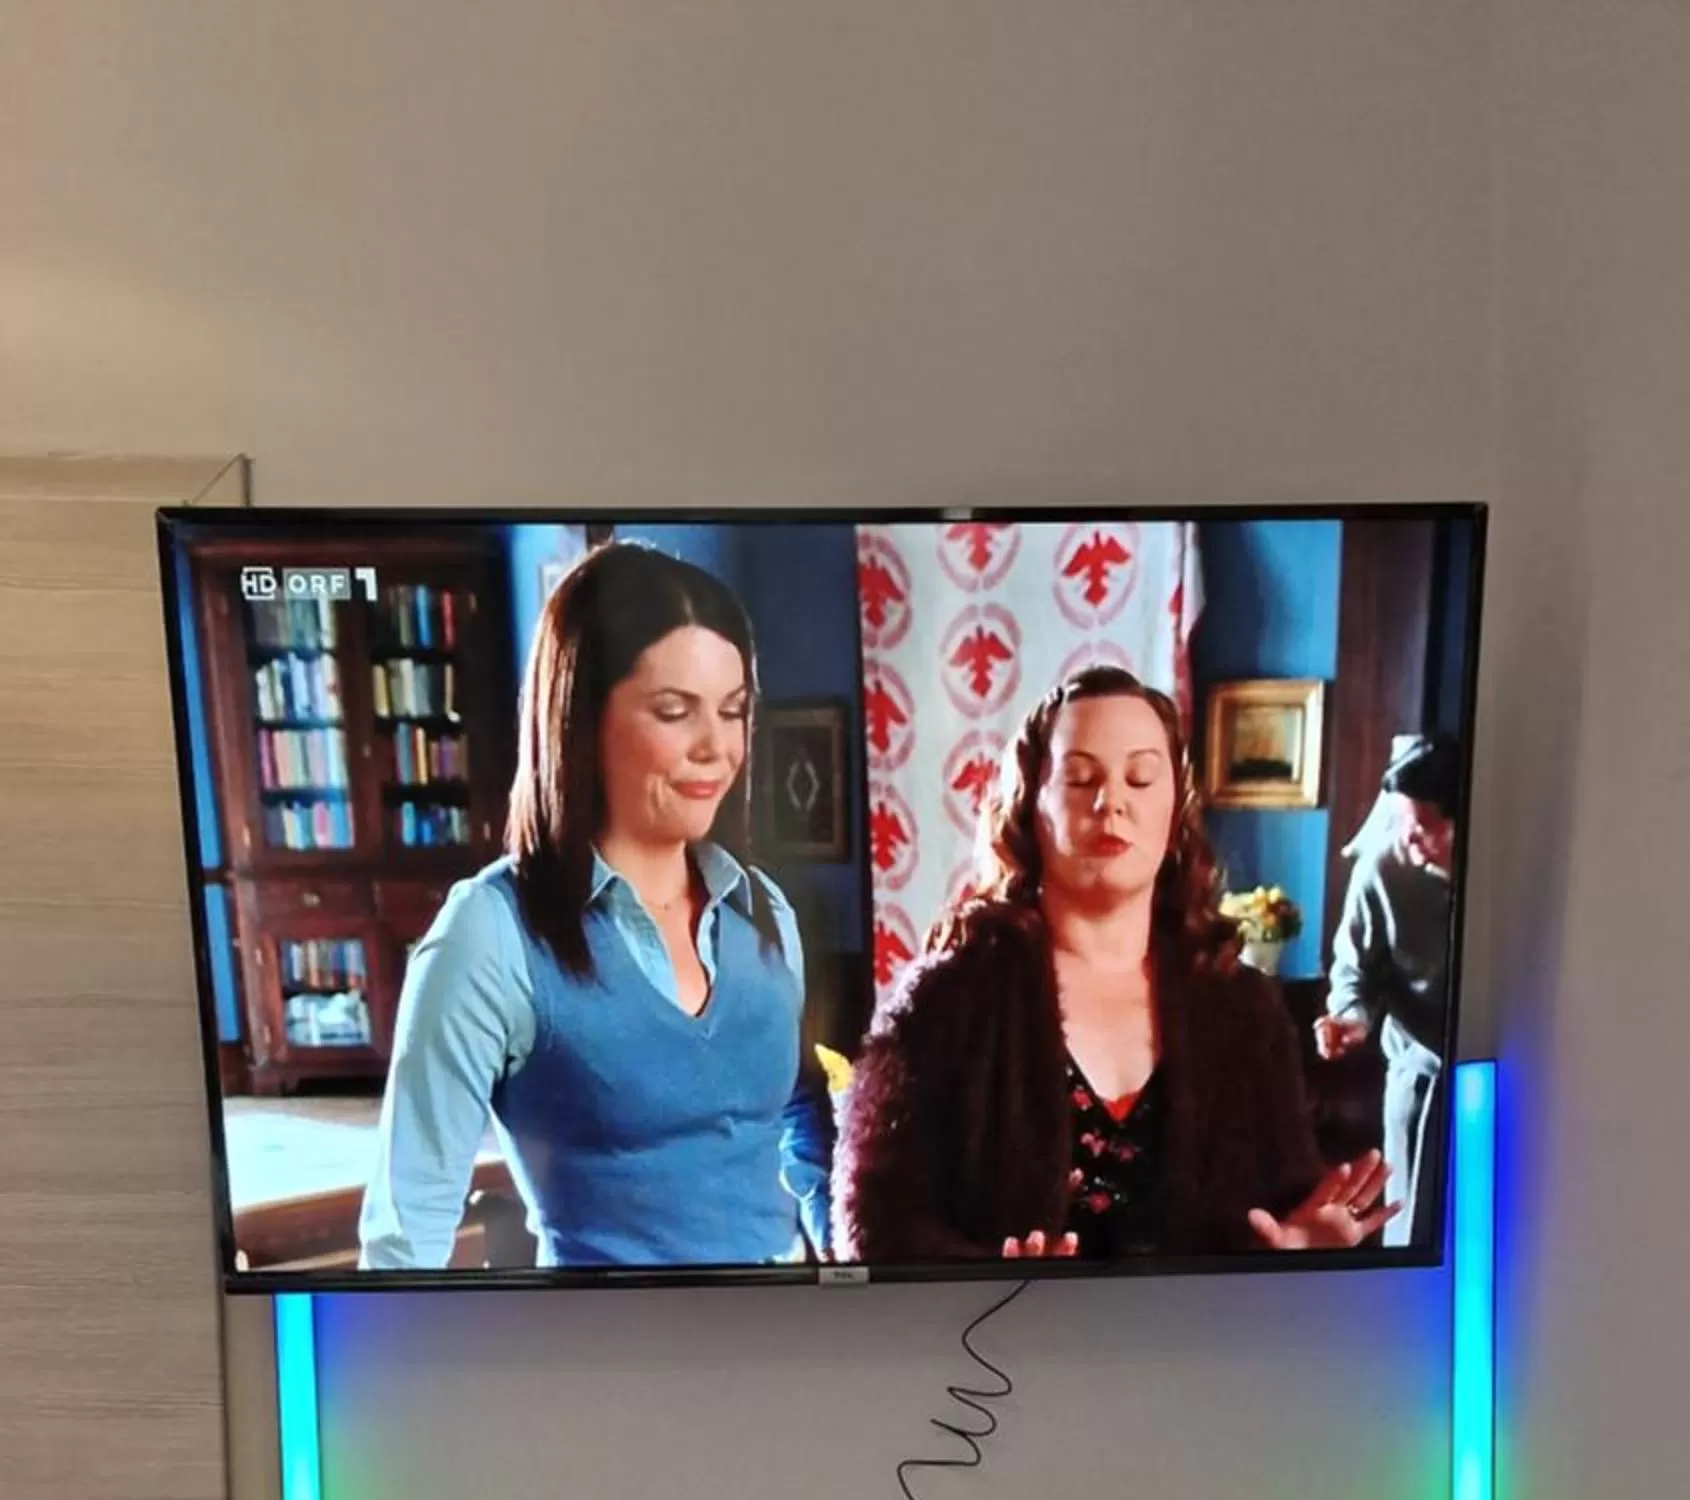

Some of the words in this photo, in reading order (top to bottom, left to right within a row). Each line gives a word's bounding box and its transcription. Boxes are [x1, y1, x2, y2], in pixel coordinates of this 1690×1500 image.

[241, 571, 277, 598] HD
[287, 573, 346, 595] ORF
[354, 567, 378, 601] 1
